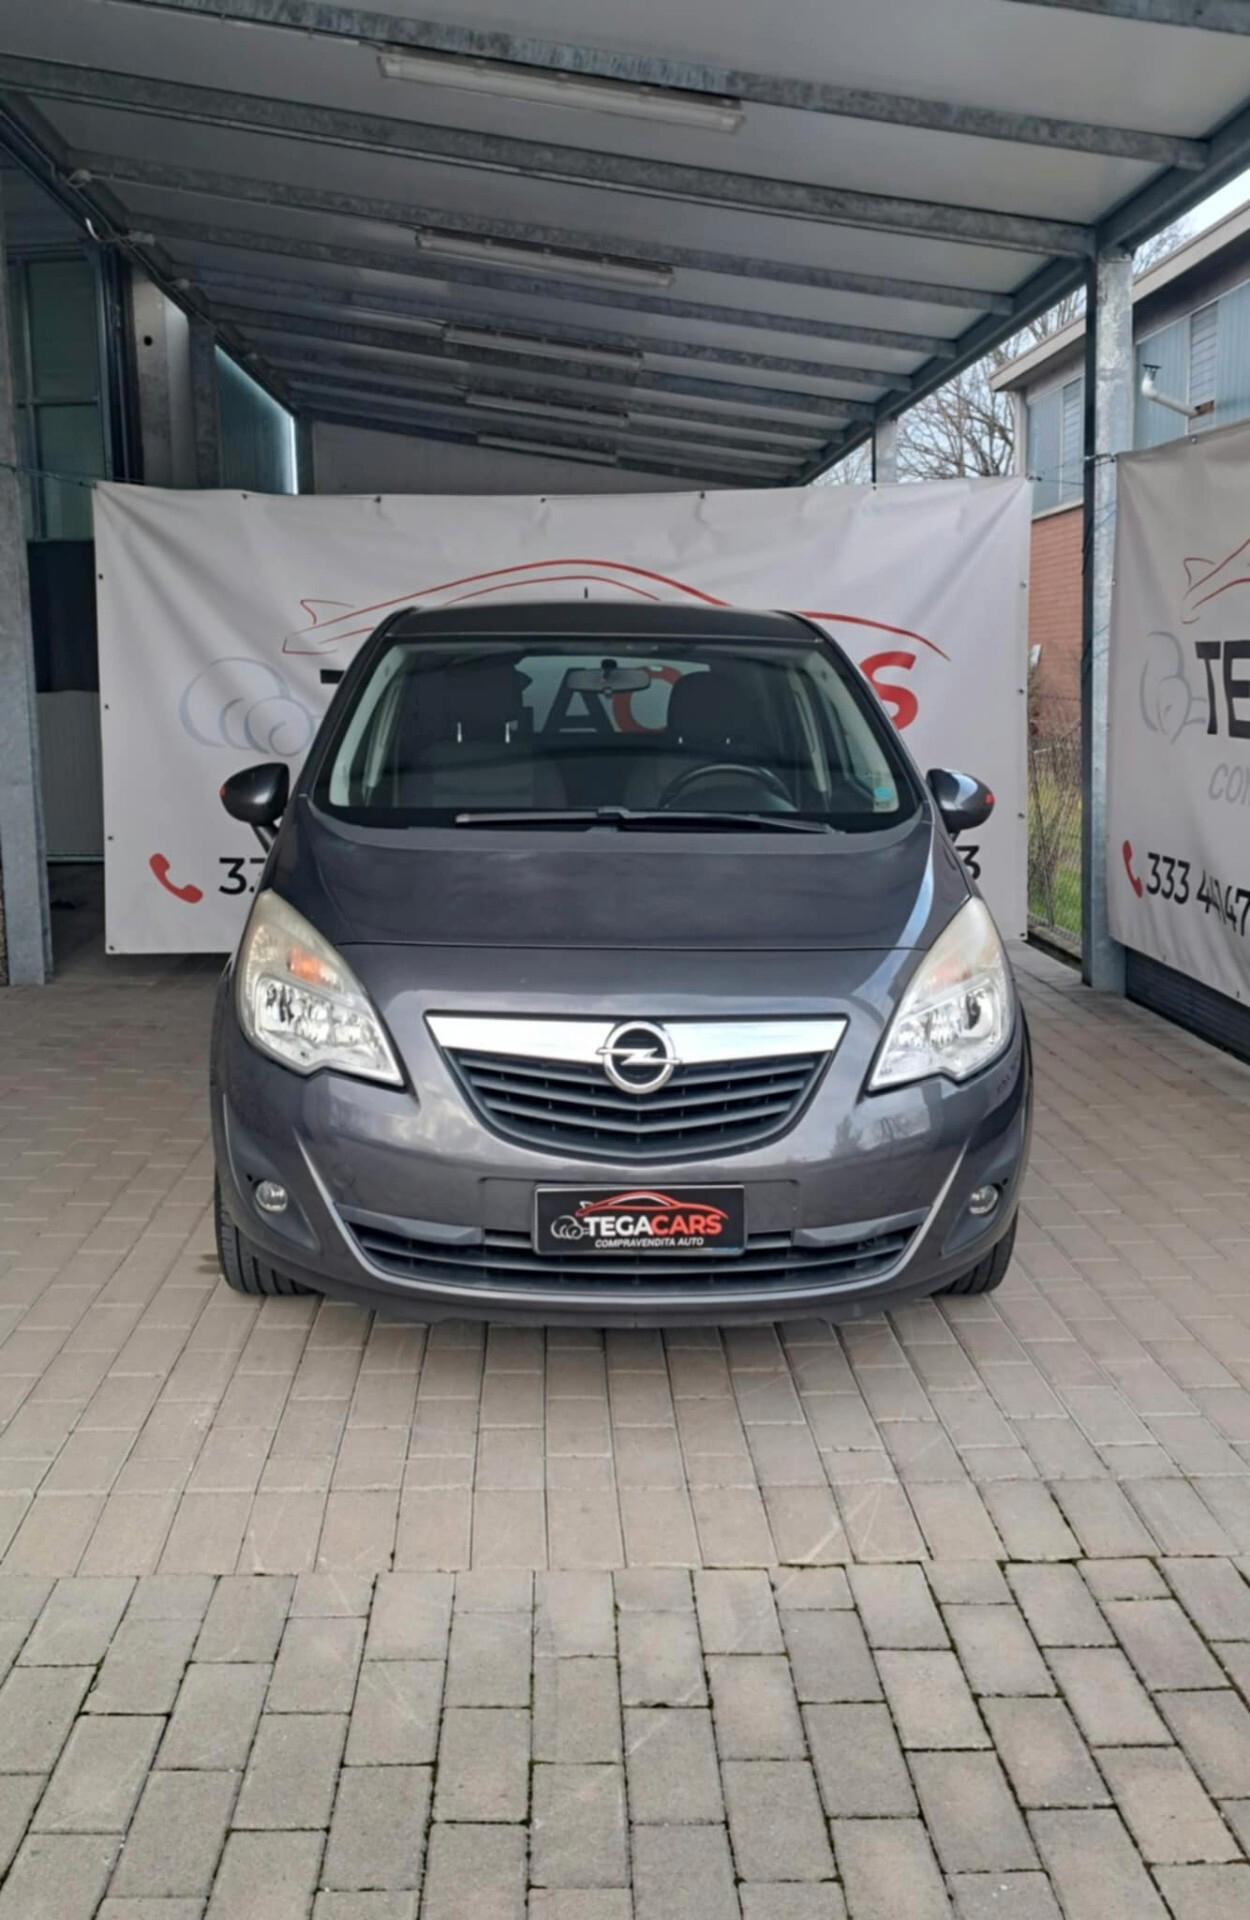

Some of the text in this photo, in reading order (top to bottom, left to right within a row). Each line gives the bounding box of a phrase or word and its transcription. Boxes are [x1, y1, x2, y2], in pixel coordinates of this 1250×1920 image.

[1146, 852, 1190, 904] 333
[583, 1214, 722, 1237] TEGACARS
[594, 1237, 704, 1249] COMPRAVENDITA AUTO
